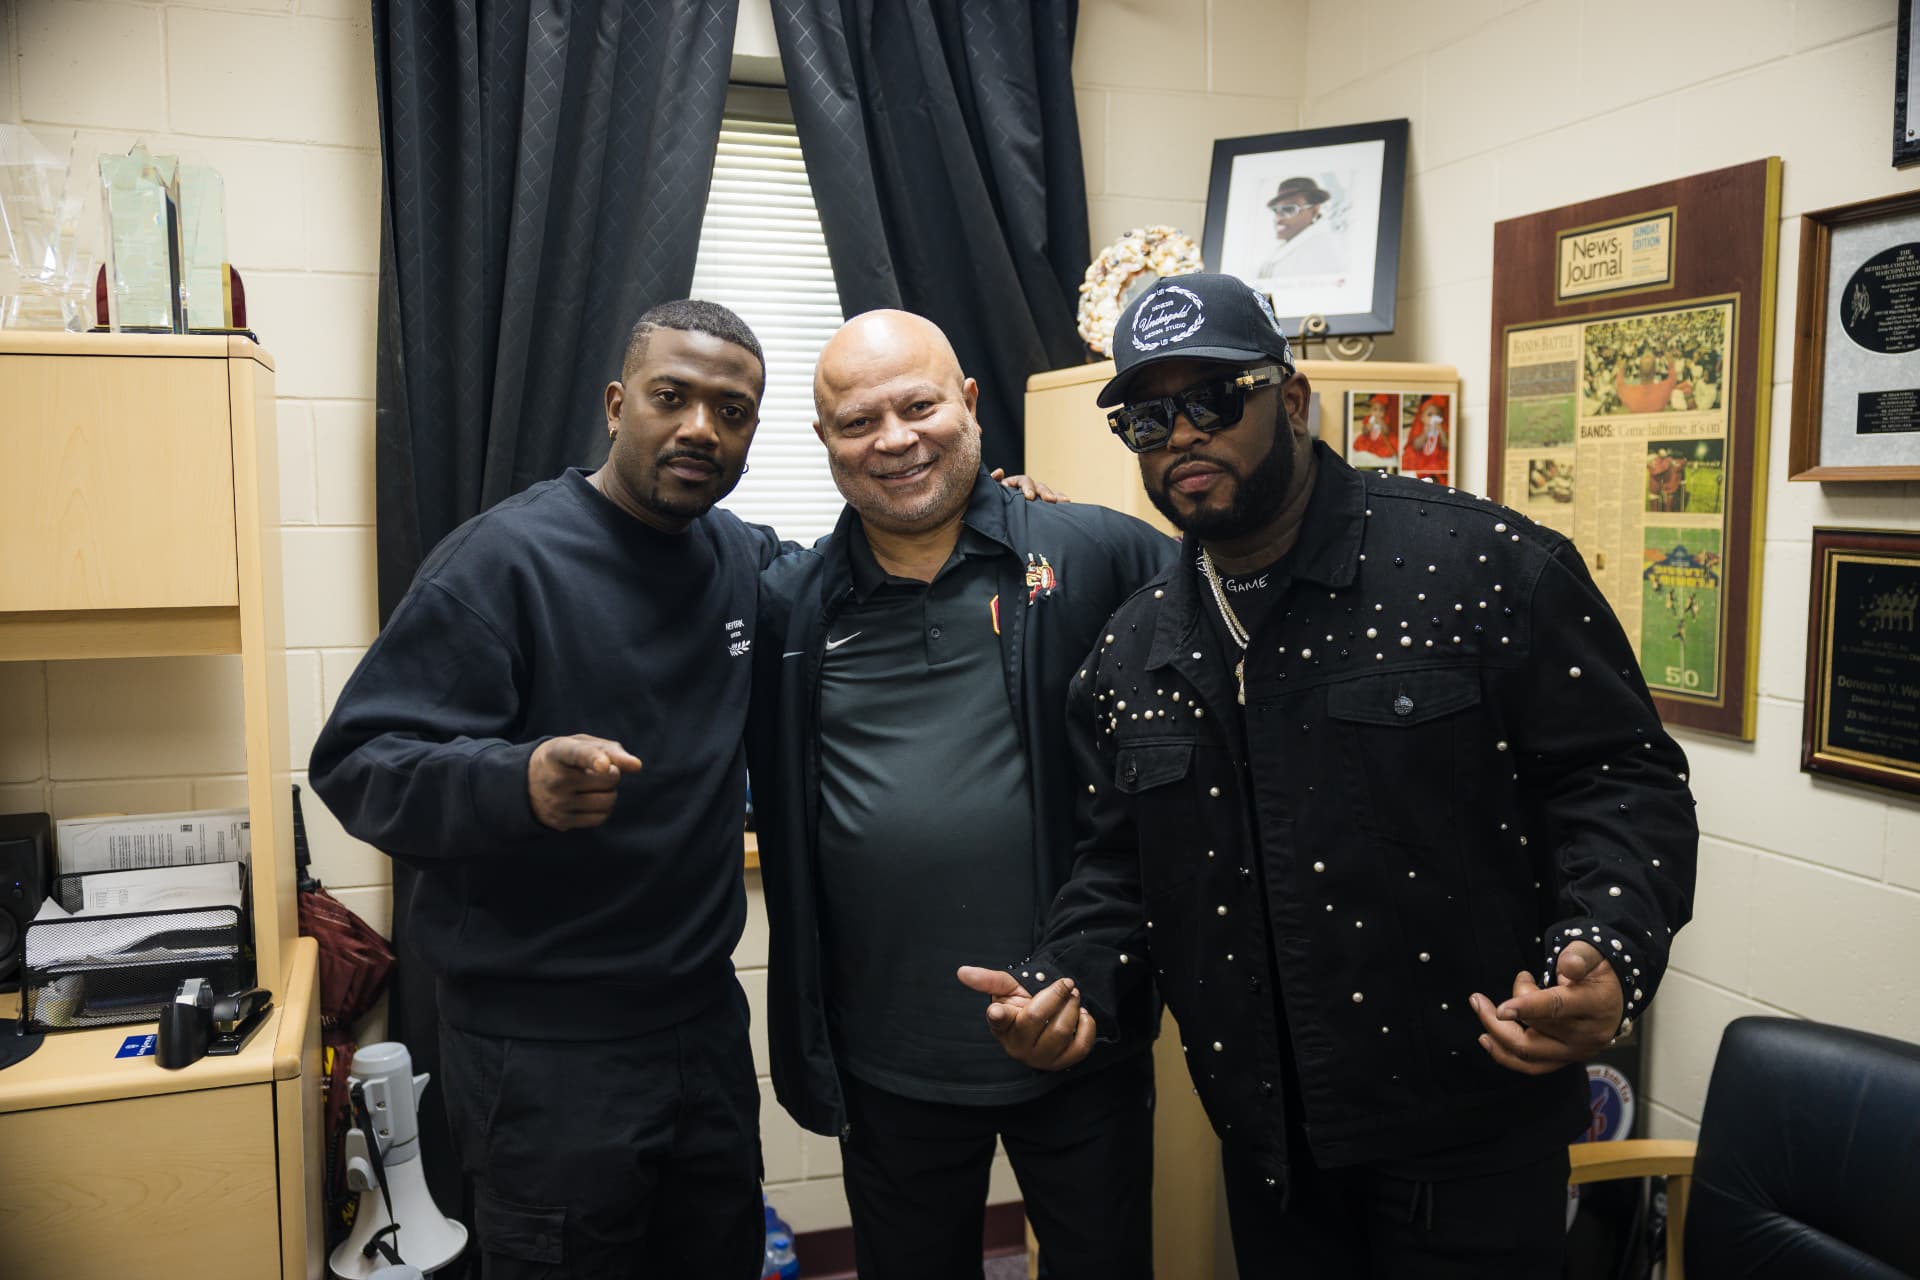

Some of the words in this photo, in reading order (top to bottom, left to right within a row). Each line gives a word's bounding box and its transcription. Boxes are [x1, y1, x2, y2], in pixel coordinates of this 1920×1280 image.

[1565, 248, 1623, 287] Journal
[1165, 322, 1187, 332] STUDIO
[1226, 573, 1269, 592] GAME
[1666, 666, 1699, 687] 50
[1837, 675, 1886, 693] Donovan
